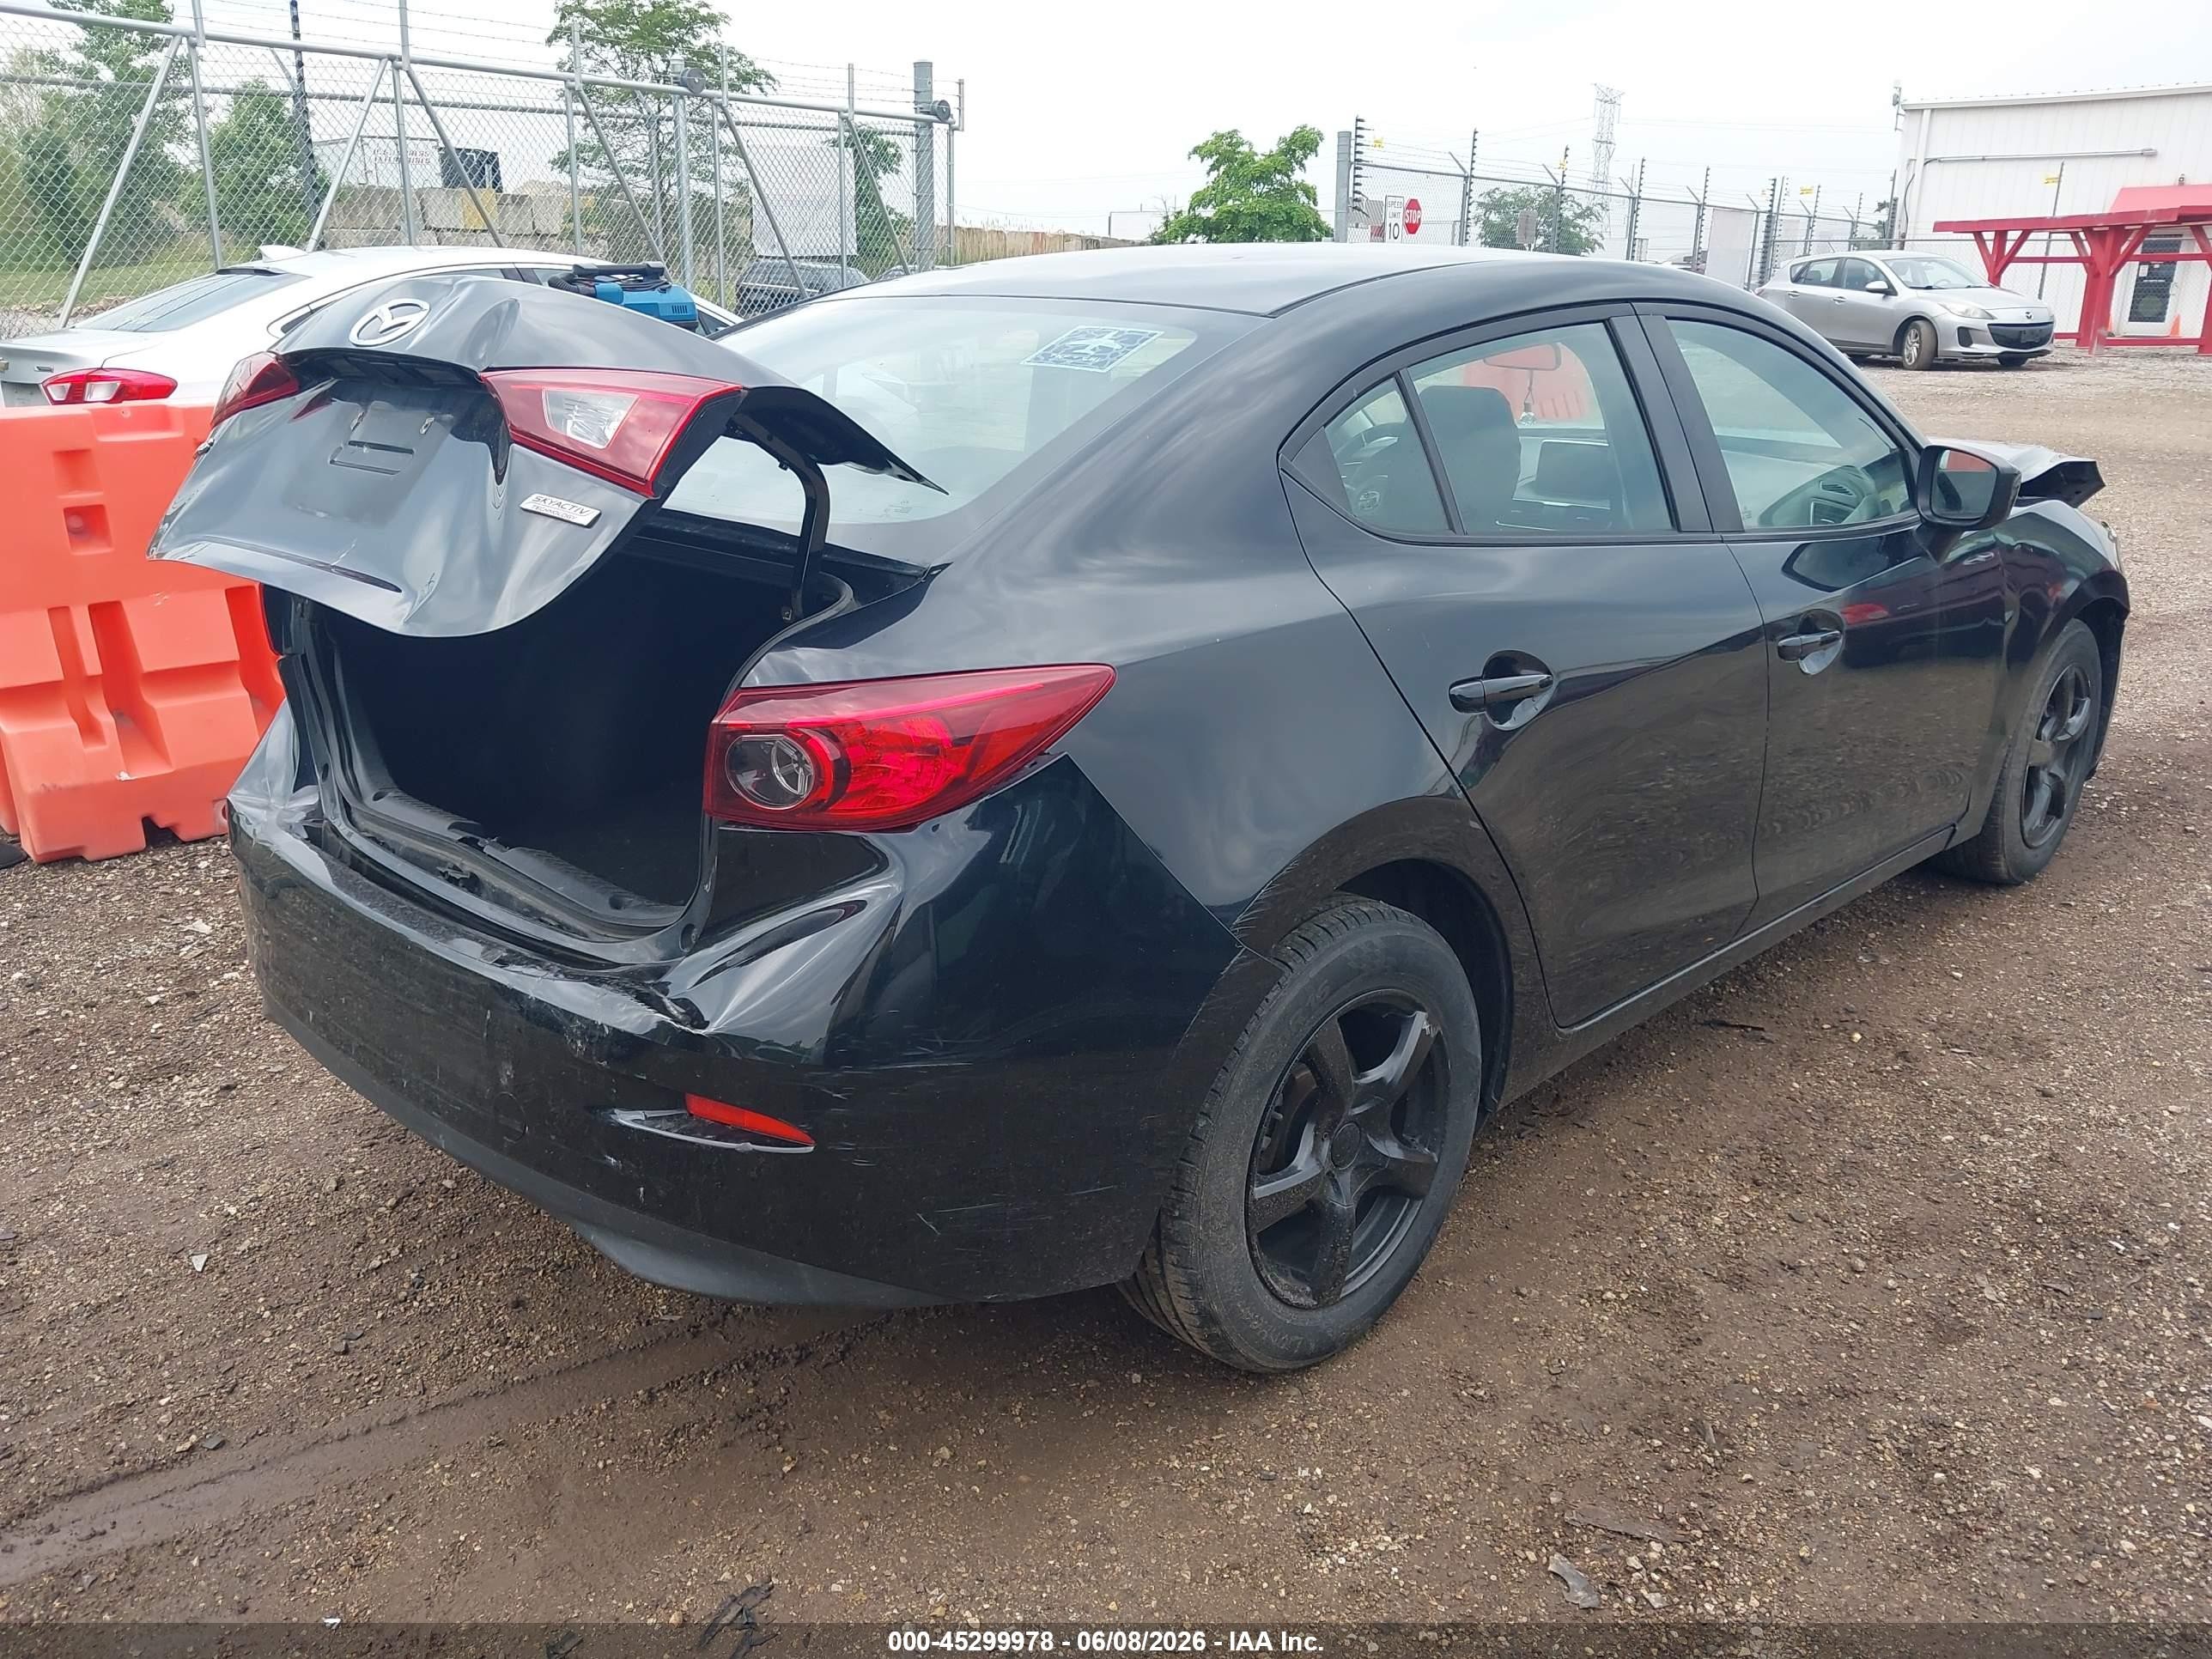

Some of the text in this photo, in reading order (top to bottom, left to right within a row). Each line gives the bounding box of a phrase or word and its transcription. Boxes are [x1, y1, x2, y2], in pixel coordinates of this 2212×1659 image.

[1388, 200, 1402, 209] SPEED
[1405, 209, 1421, 223] STOP
[1389, 222, 1400, 240] 10
[532, 495, 590, 514] SKYACTIV
[532, 504, 578, 520] TECHNOLOGY
